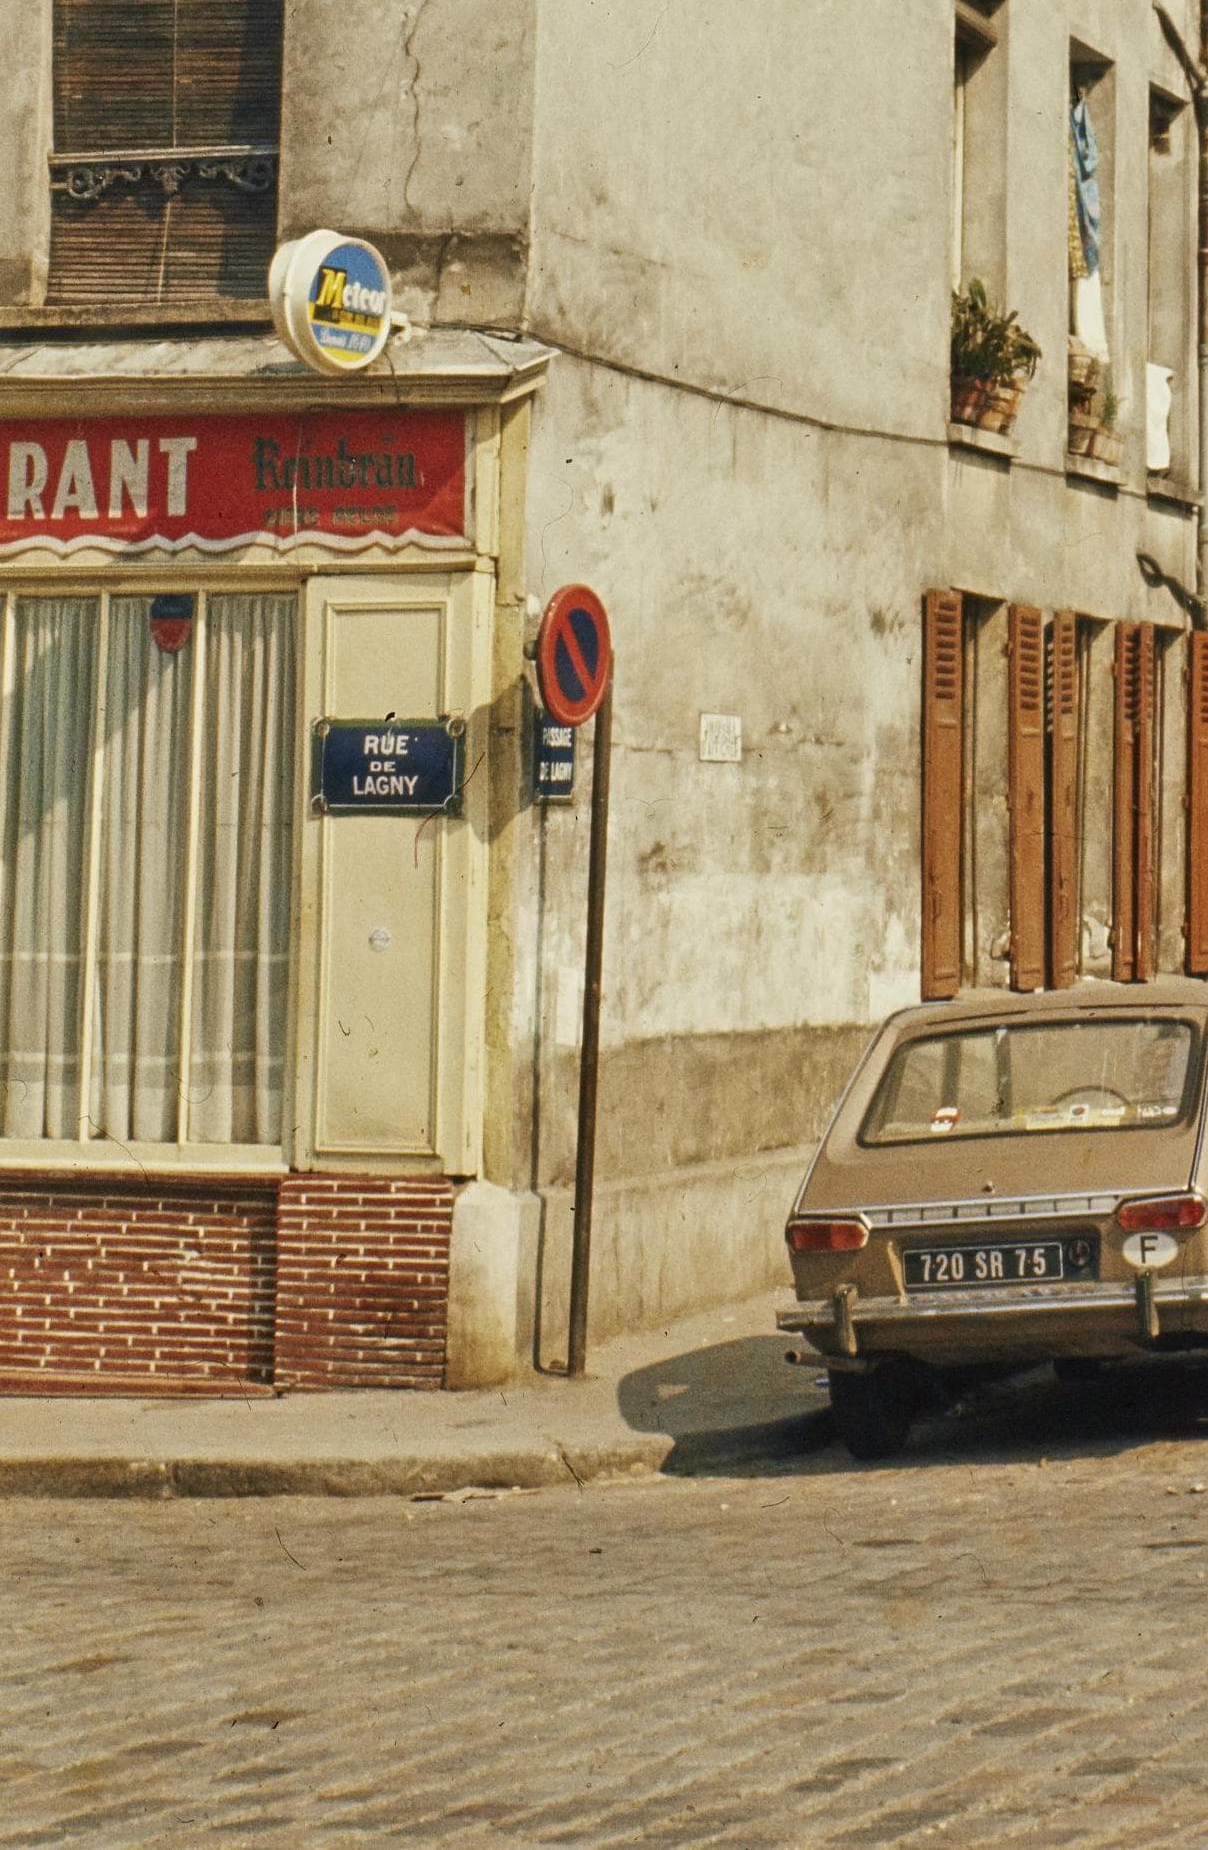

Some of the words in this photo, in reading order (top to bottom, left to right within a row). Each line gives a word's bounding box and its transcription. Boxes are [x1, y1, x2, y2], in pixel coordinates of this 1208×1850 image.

[315, 267, 386, 316] Meteor
[6, 436, 198, 520] RANT
[363, 734, 410, 755] RUE
[542, 726, 572, 747] PASSAGE
[369, 761, 396, 772] DE
[540, 761, 549, 781] DE
[550, 761, 572, 782] LAGNY
[352, 775, 418, 795] LAGNY
[1139, 1235, 1158, 1264] F
[920, 1253, 965, 1283] 720
[975, 1250, 1004, 1279] SR
[1014, 1247, 1047, 1276] 75
